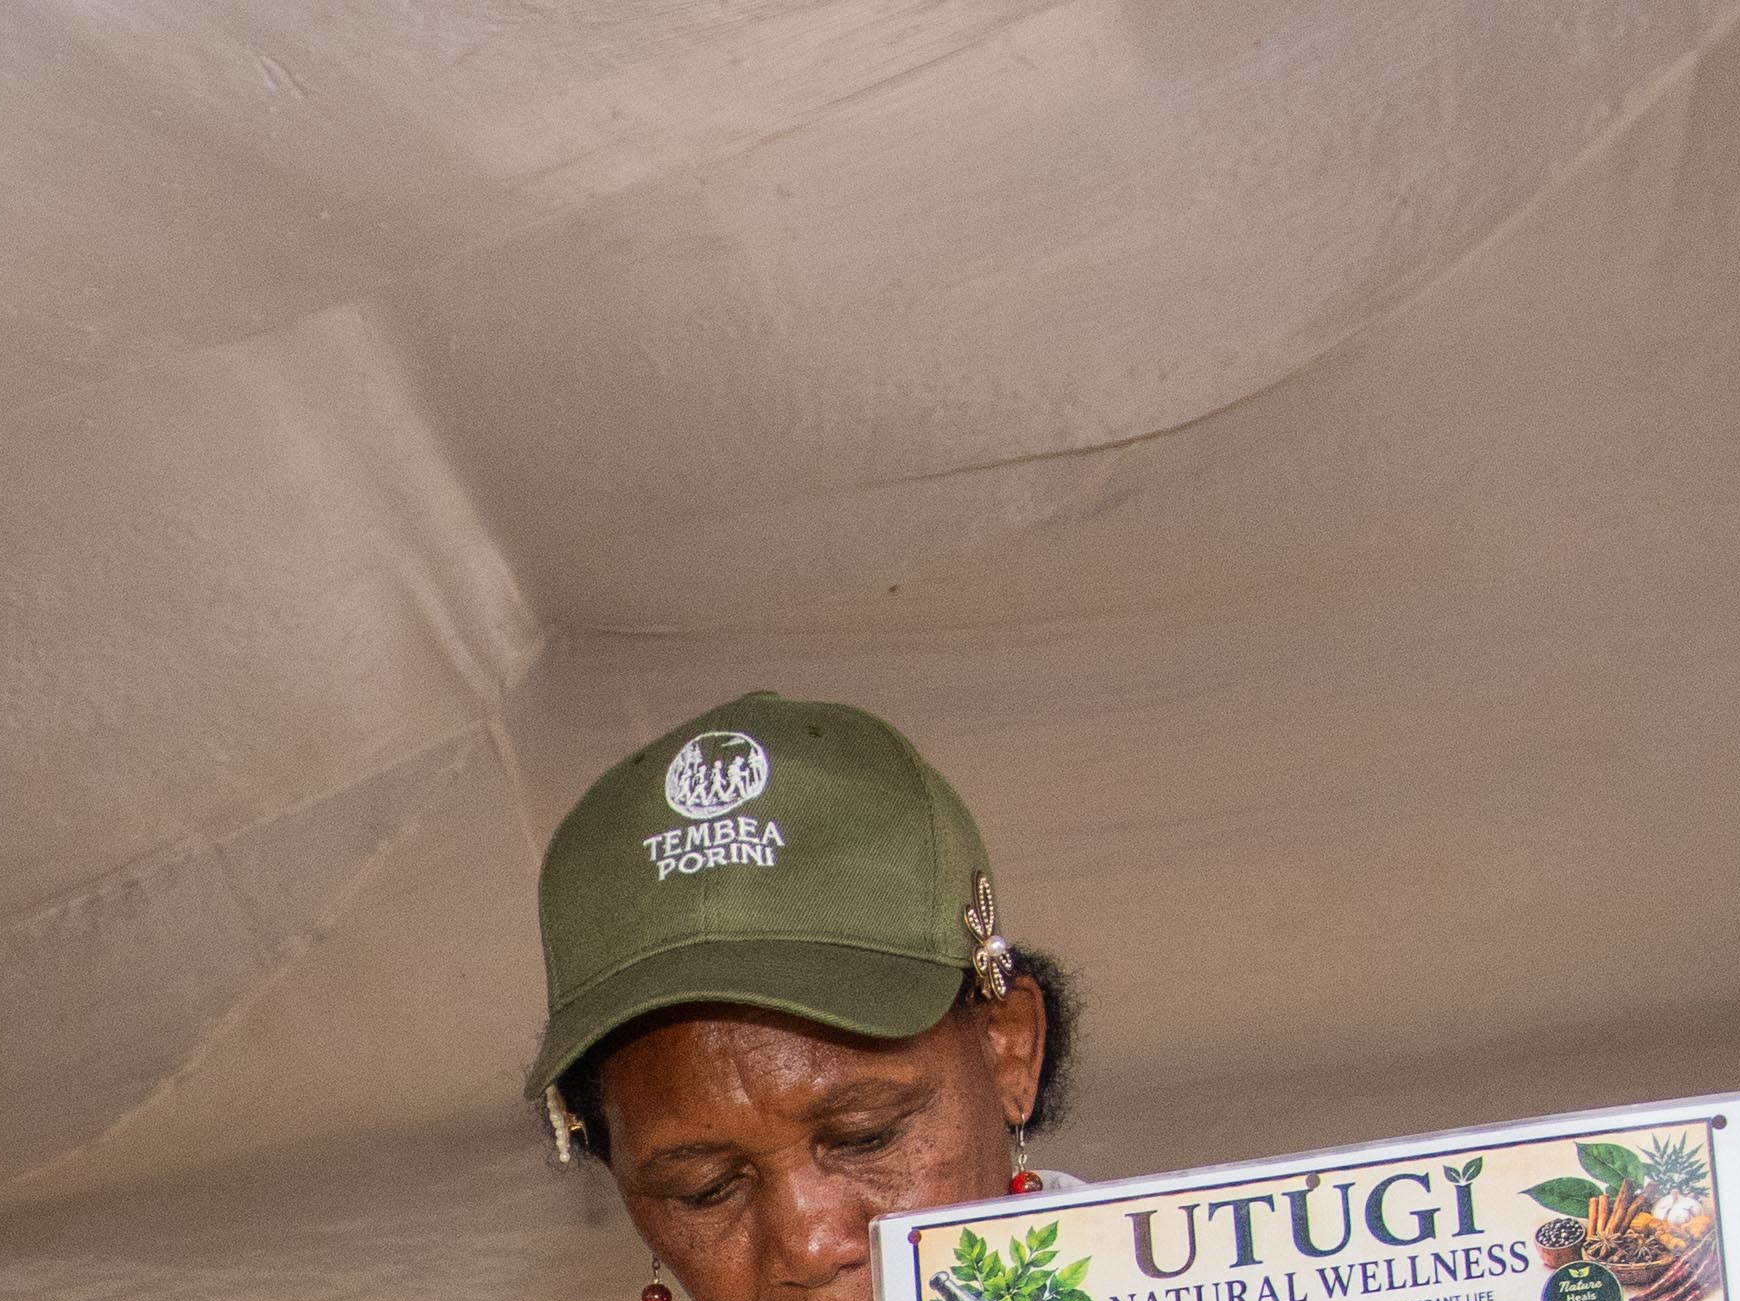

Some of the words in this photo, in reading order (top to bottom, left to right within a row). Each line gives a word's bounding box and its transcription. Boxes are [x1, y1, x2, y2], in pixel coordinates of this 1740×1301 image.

[643, 815, 784, 863] TEMBEA
[657, 844, 774, 880] PORINI
[1125, 1155, 1484, 1279] UTUGI
[1315, 1240, 1530, 1298] WELLNESS
[1558, 1279, 1603, 1293] Nature
